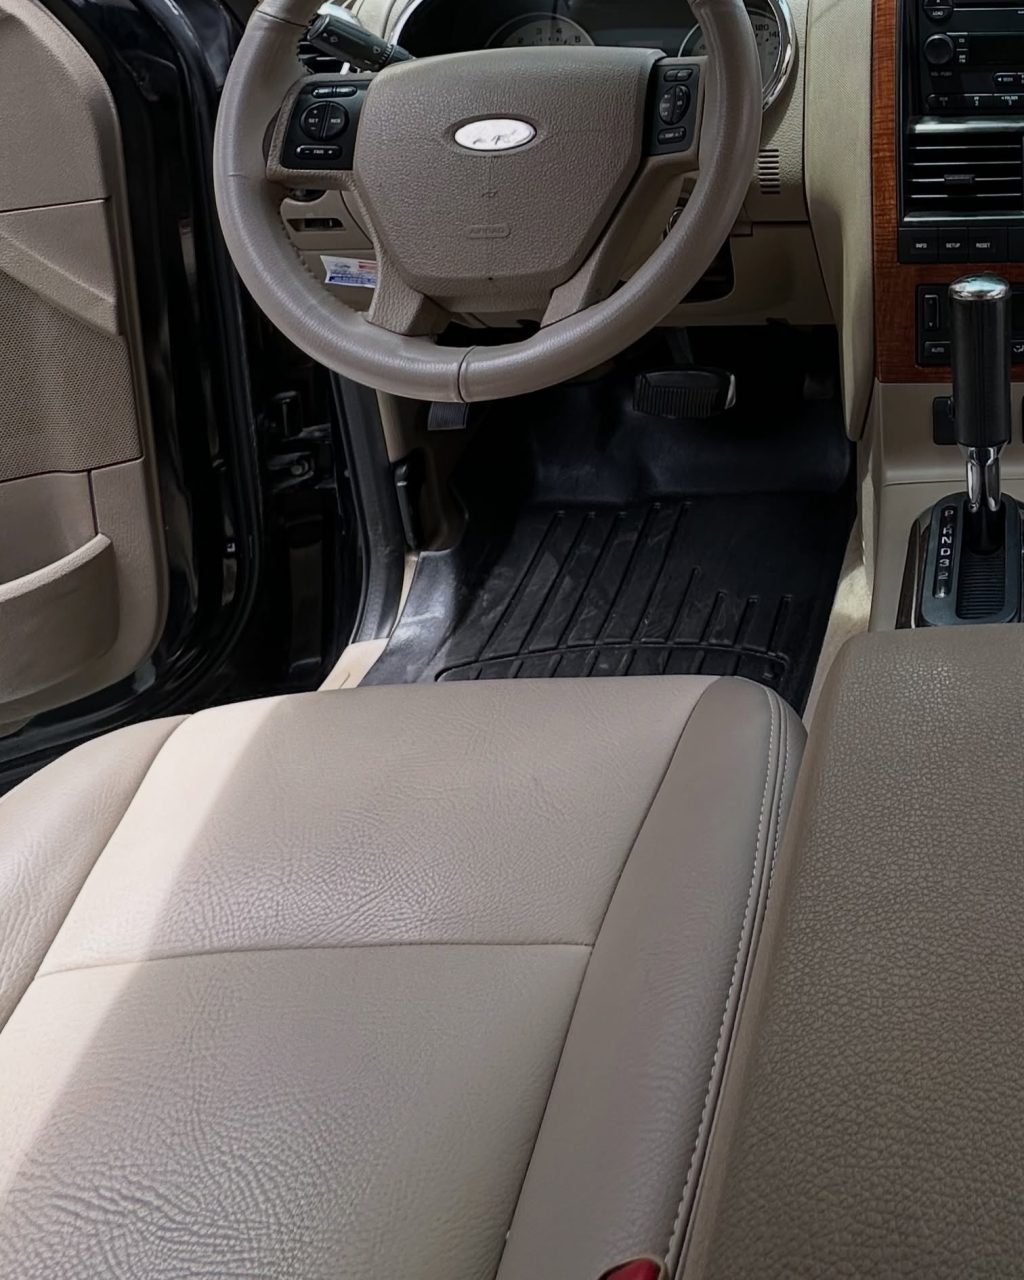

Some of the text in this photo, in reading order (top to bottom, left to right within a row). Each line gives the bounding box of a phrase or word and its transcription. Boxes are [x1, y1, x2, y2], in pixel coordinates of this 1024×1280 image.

[944, 509, 954, 517] P
[941, 536, 952, 544] N
[940, 547, 951, 556] D
[939, 558, 950, 567] 3
[937, 571, 949, 580] 2
